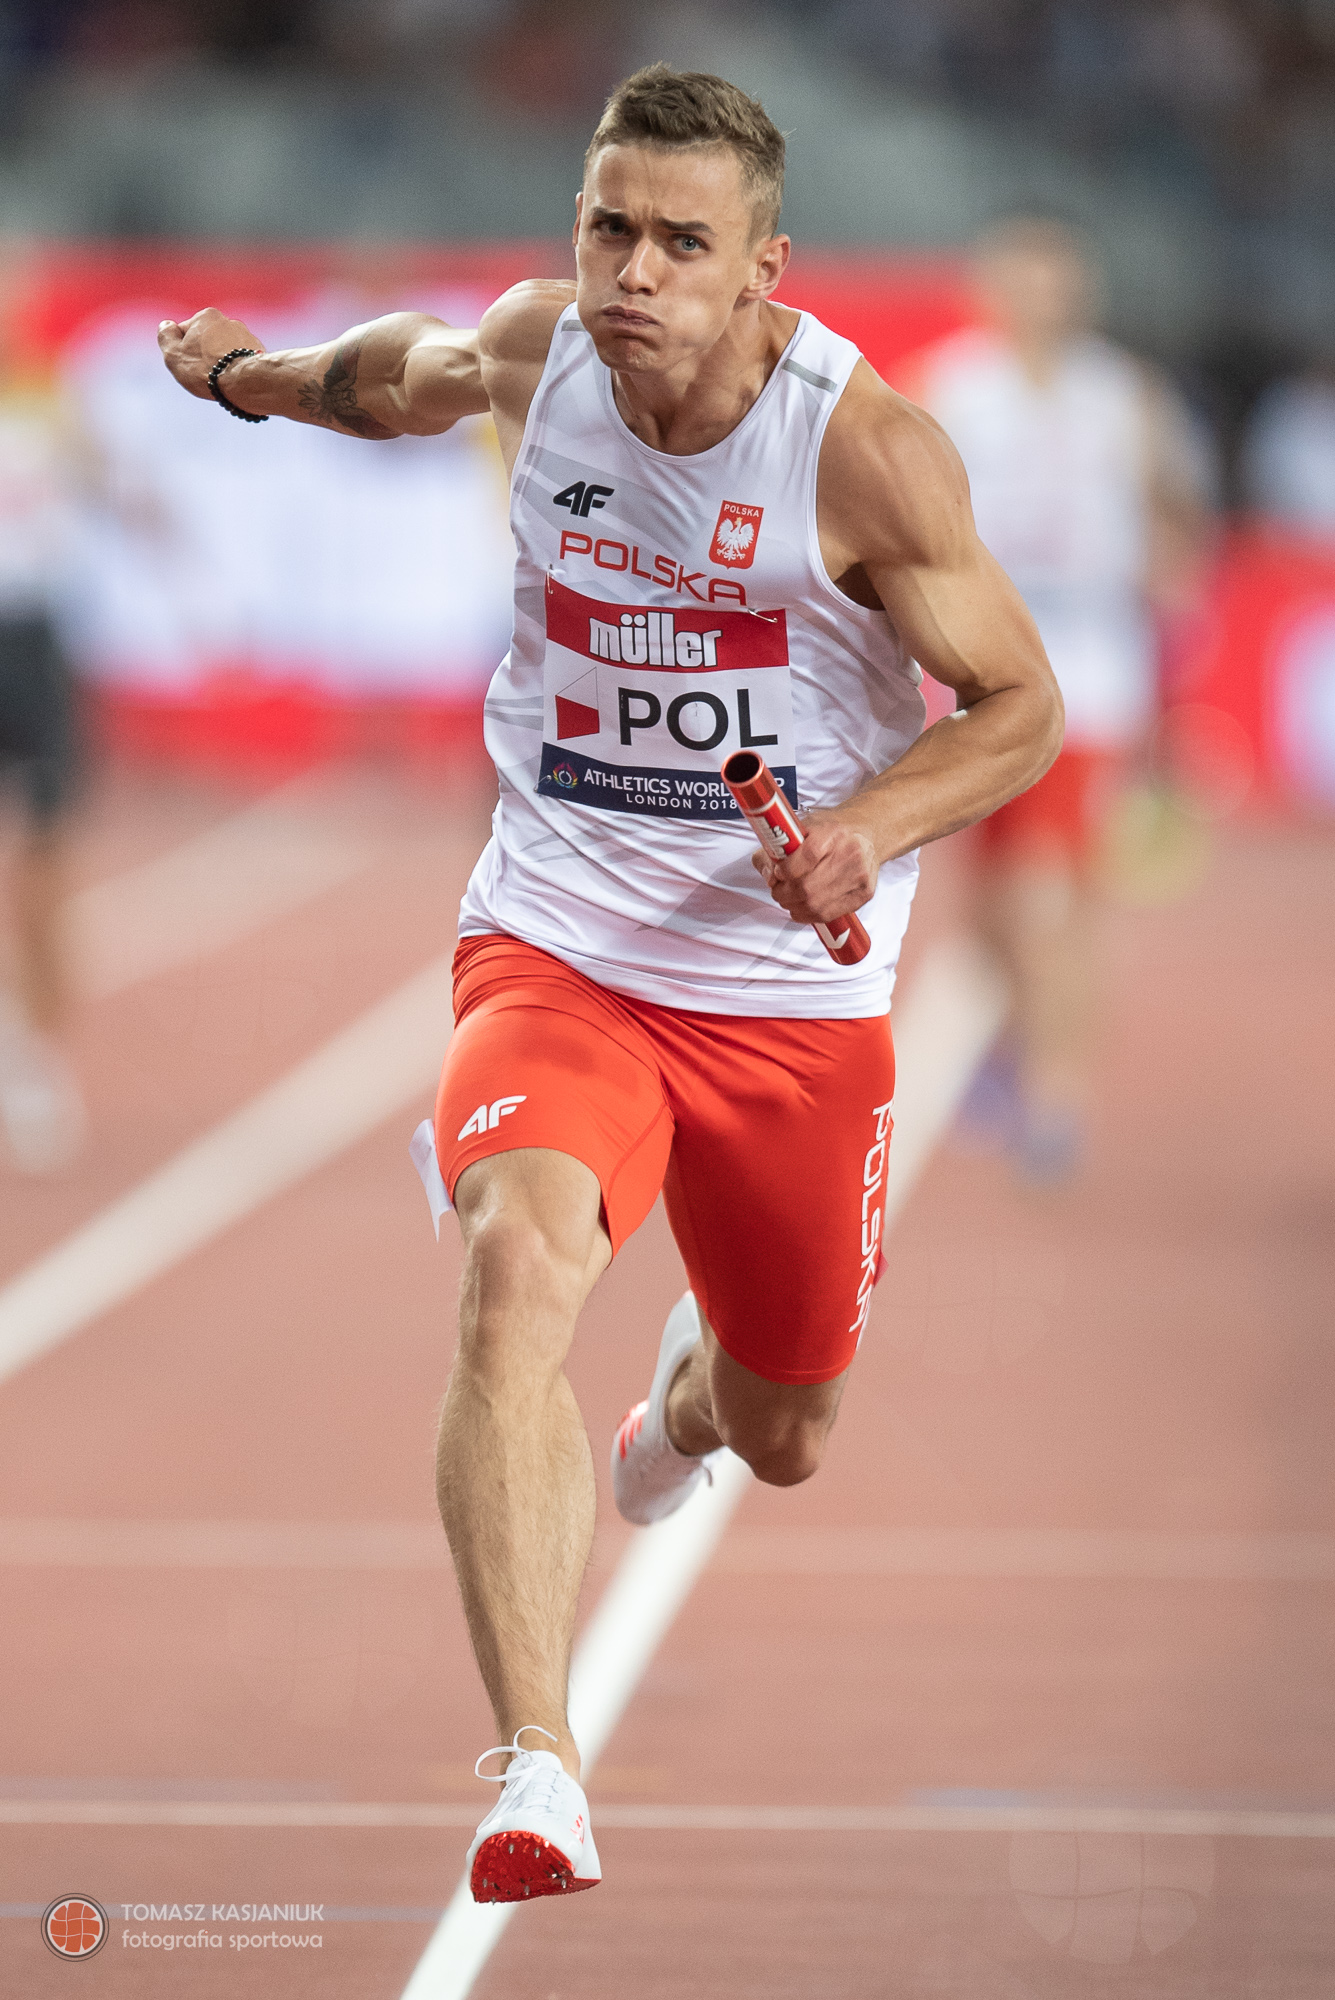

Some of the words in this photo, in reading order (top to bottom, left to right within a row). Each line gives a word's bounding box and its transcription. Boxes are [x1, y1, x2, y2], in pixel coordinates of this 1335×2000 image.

[553, 481, 615, 518] 4F
[723, 503, 760, 518] POLSKA
[559, 529, 747, 606] POLSKA
[589, 610, 722, 668] müller
[617, 687, 778, 751] POL
[583, 768, 671, 793] ATHLETICS
[675, 780, 732, 797] WORL
[626, 793, 692, 809] LONDON
[699, 799, 738, 810] 2018
[848, 1100, 893, 1333] POLSKA
